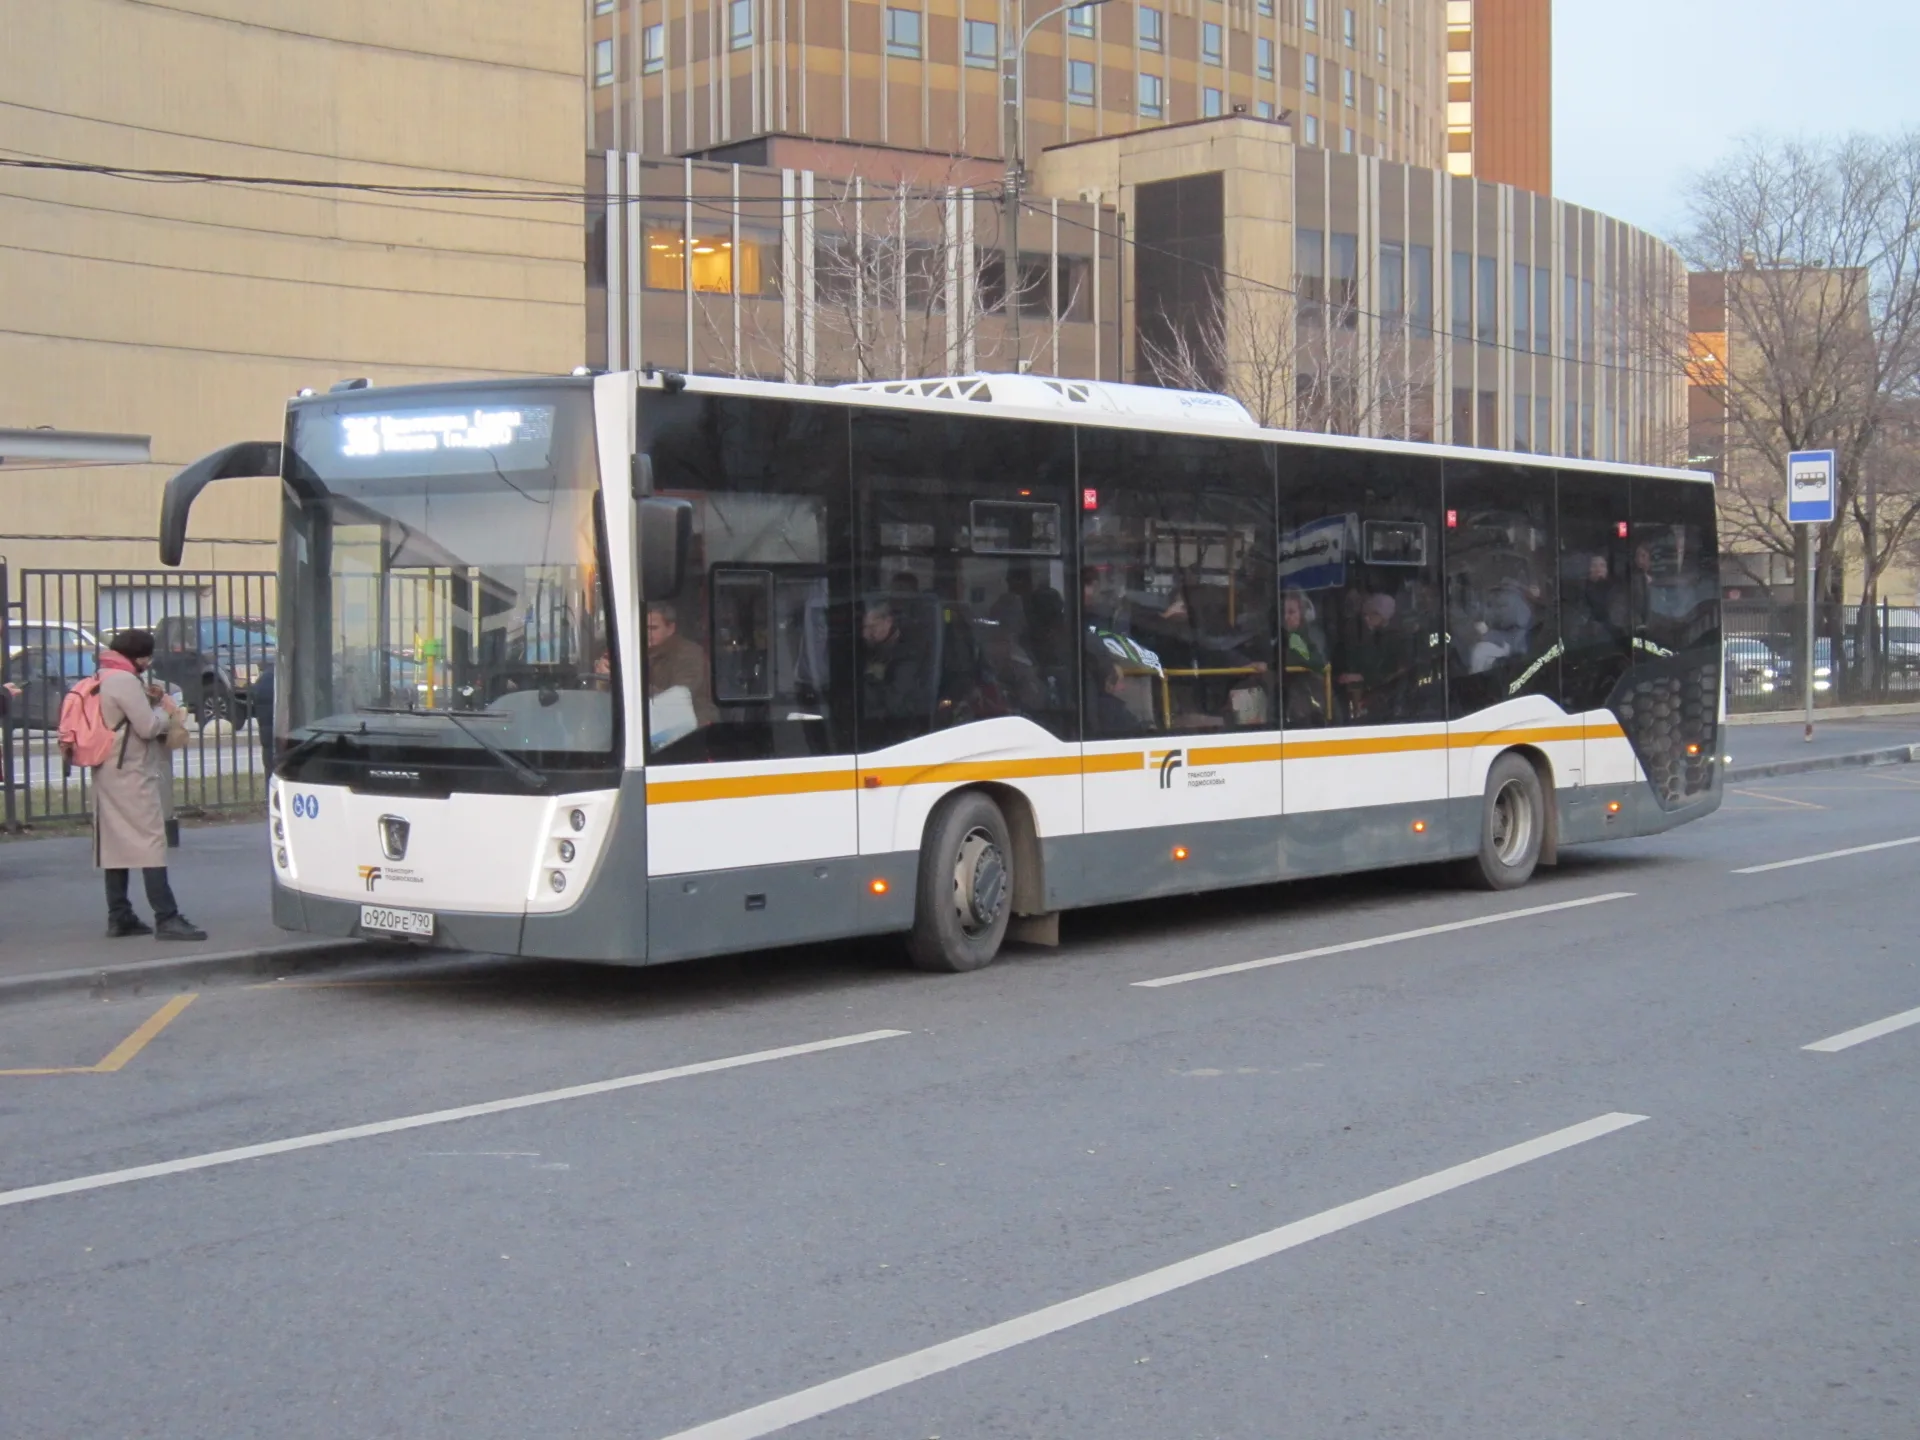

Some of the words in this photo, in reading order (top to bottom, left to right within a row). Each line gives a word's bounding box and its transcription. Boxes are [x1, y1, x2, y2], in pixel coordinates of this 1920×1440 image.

[1187, 770, 1216, 778] ТРАНСПОРТ
[1187, 778, 1226, 787] ПОДМОСКОВЬЯ
[384, 867, 414, 875] ТРАНСПОРТ
[384, 874, 424, 883] ПОДМОСКОВЬЯ
